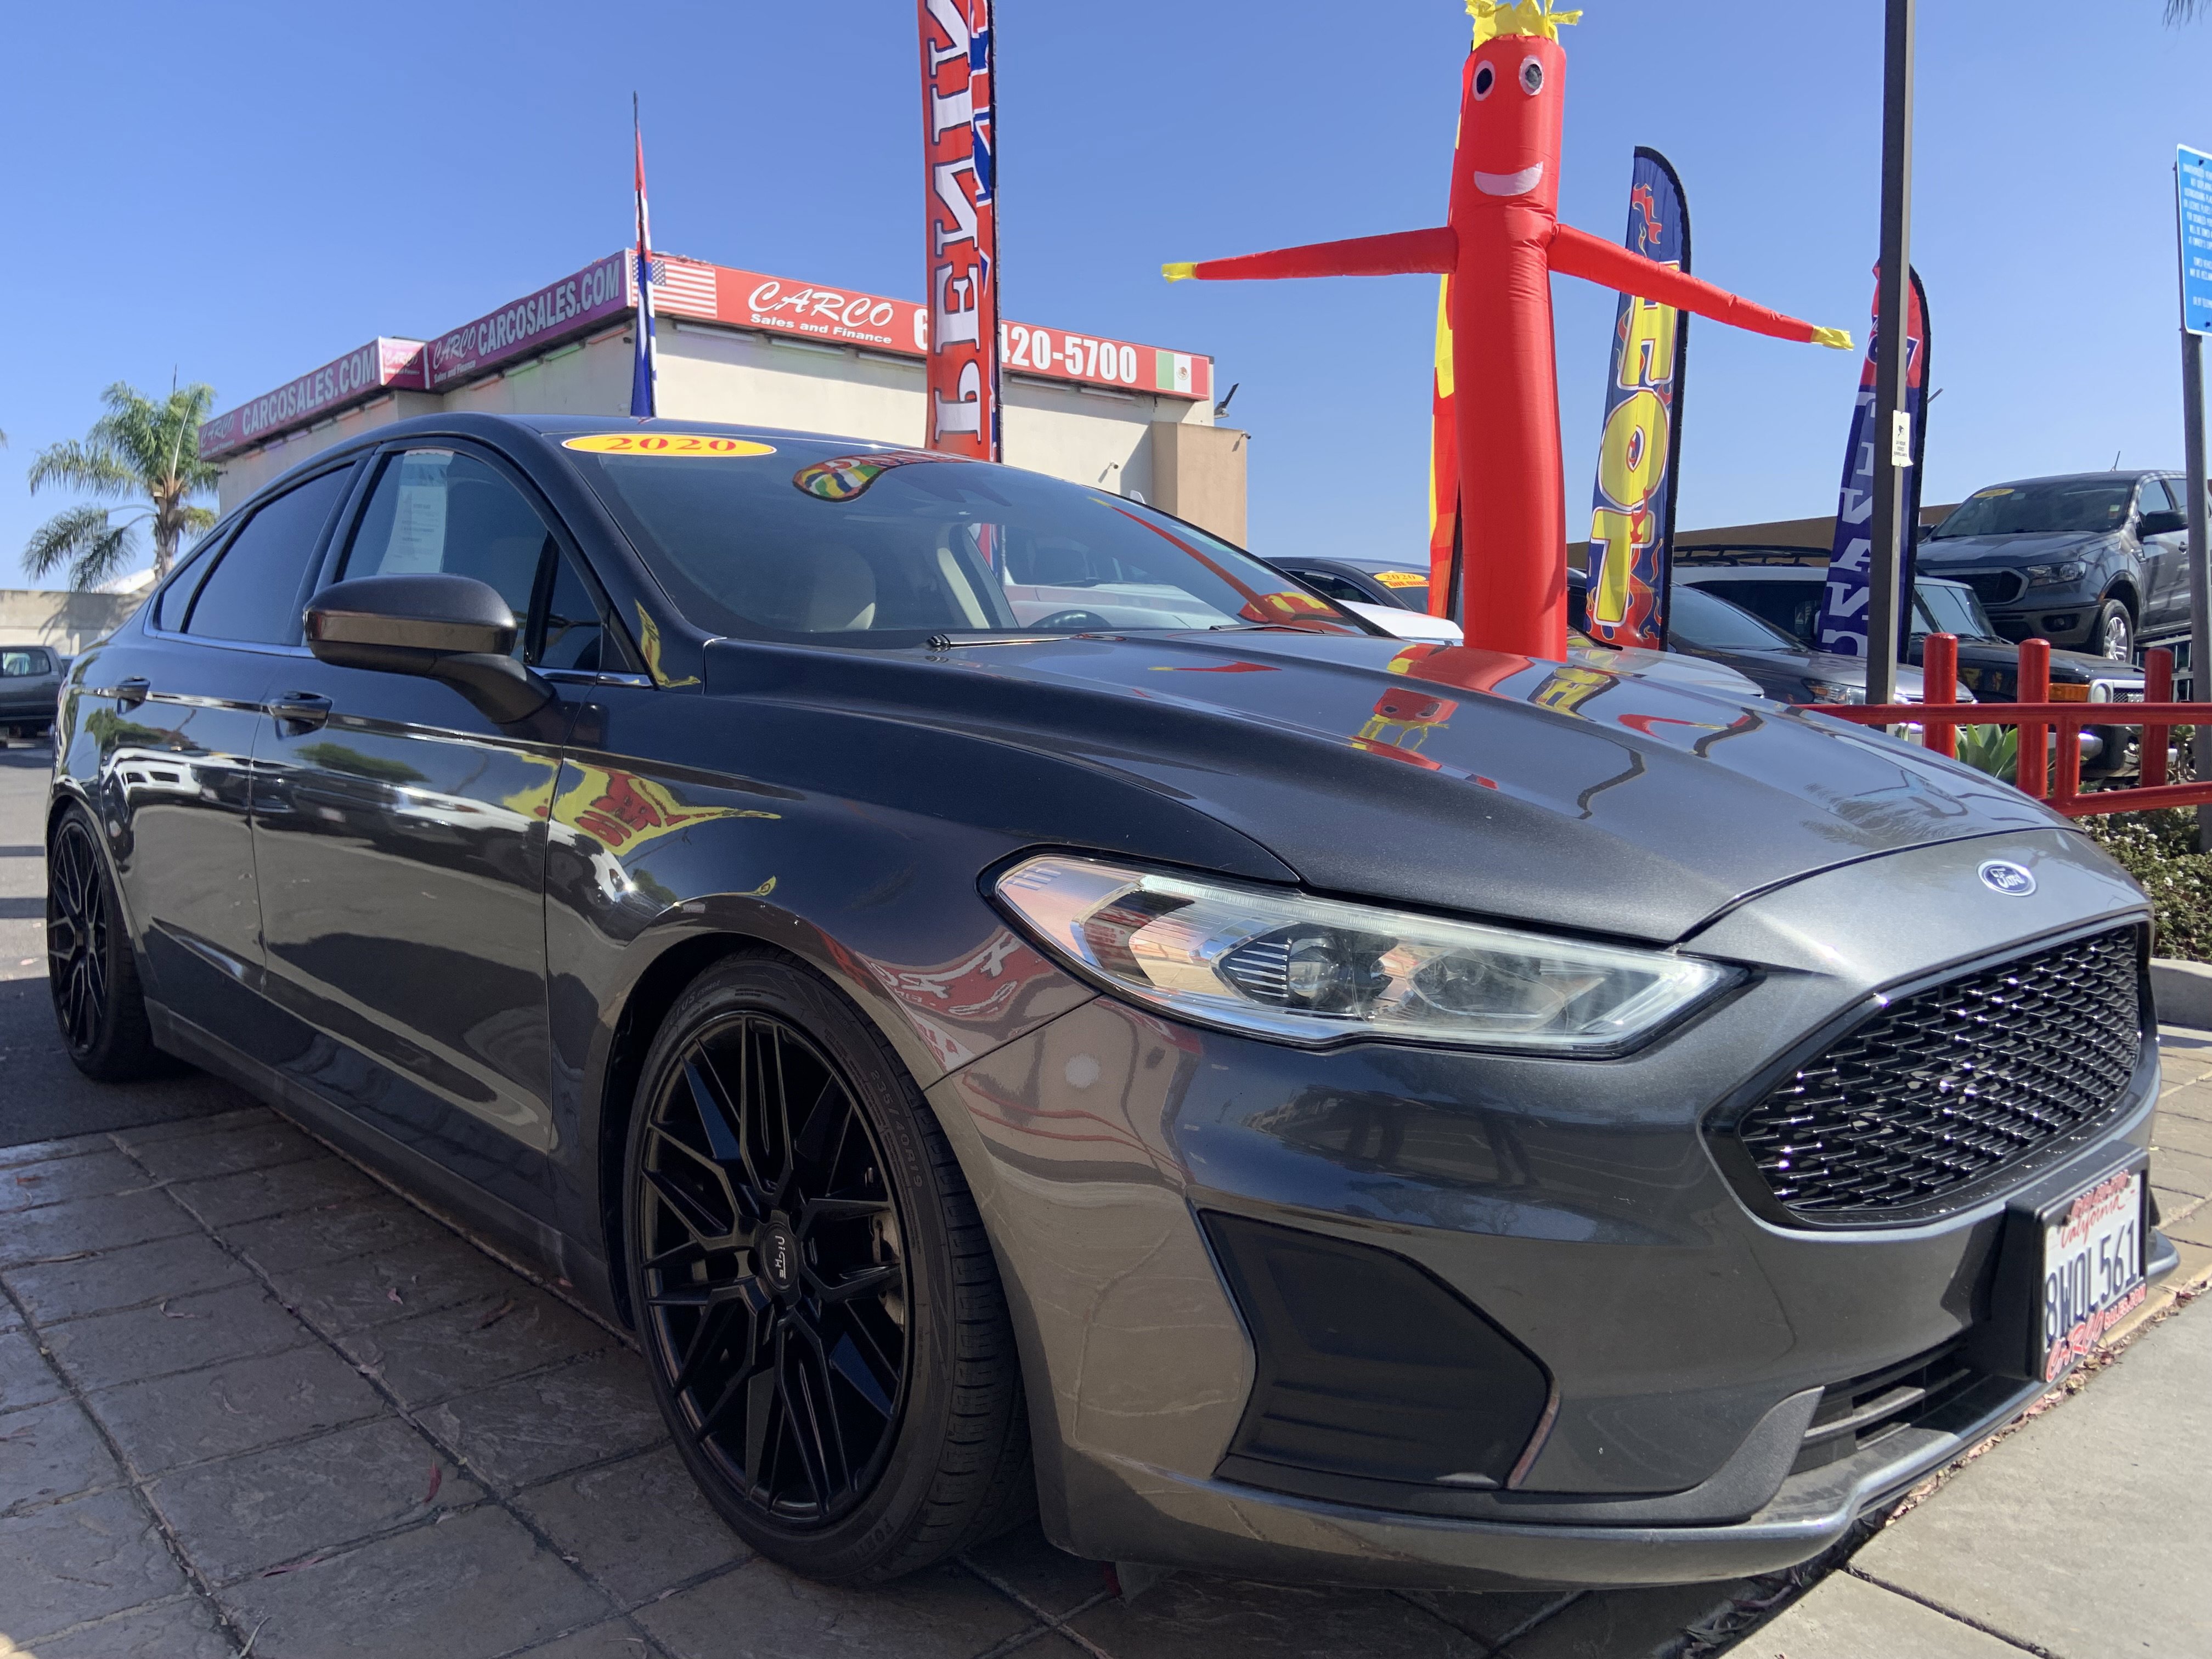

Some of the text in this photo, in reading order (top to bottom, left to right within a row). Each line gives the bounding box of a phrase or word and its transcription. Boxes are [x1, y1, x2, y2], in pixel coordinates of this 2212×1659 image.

[433, 259, 620, 370] CARCO CARCOSALES.COM
[748, 281, 894, 328] CARCO
[750, 313, 893, 345] Sales and Finance
[242, 346, 376, 436] CARCOSALES.COM
[605, 438, 736, 452] 2020
[1590, 260, 1680, 628] HOT
[1989, 867, 2025, 889] Ford
[2061, 1195, 2126, 1249] California
[2045, 1308, 2104, 1383] CARCO
